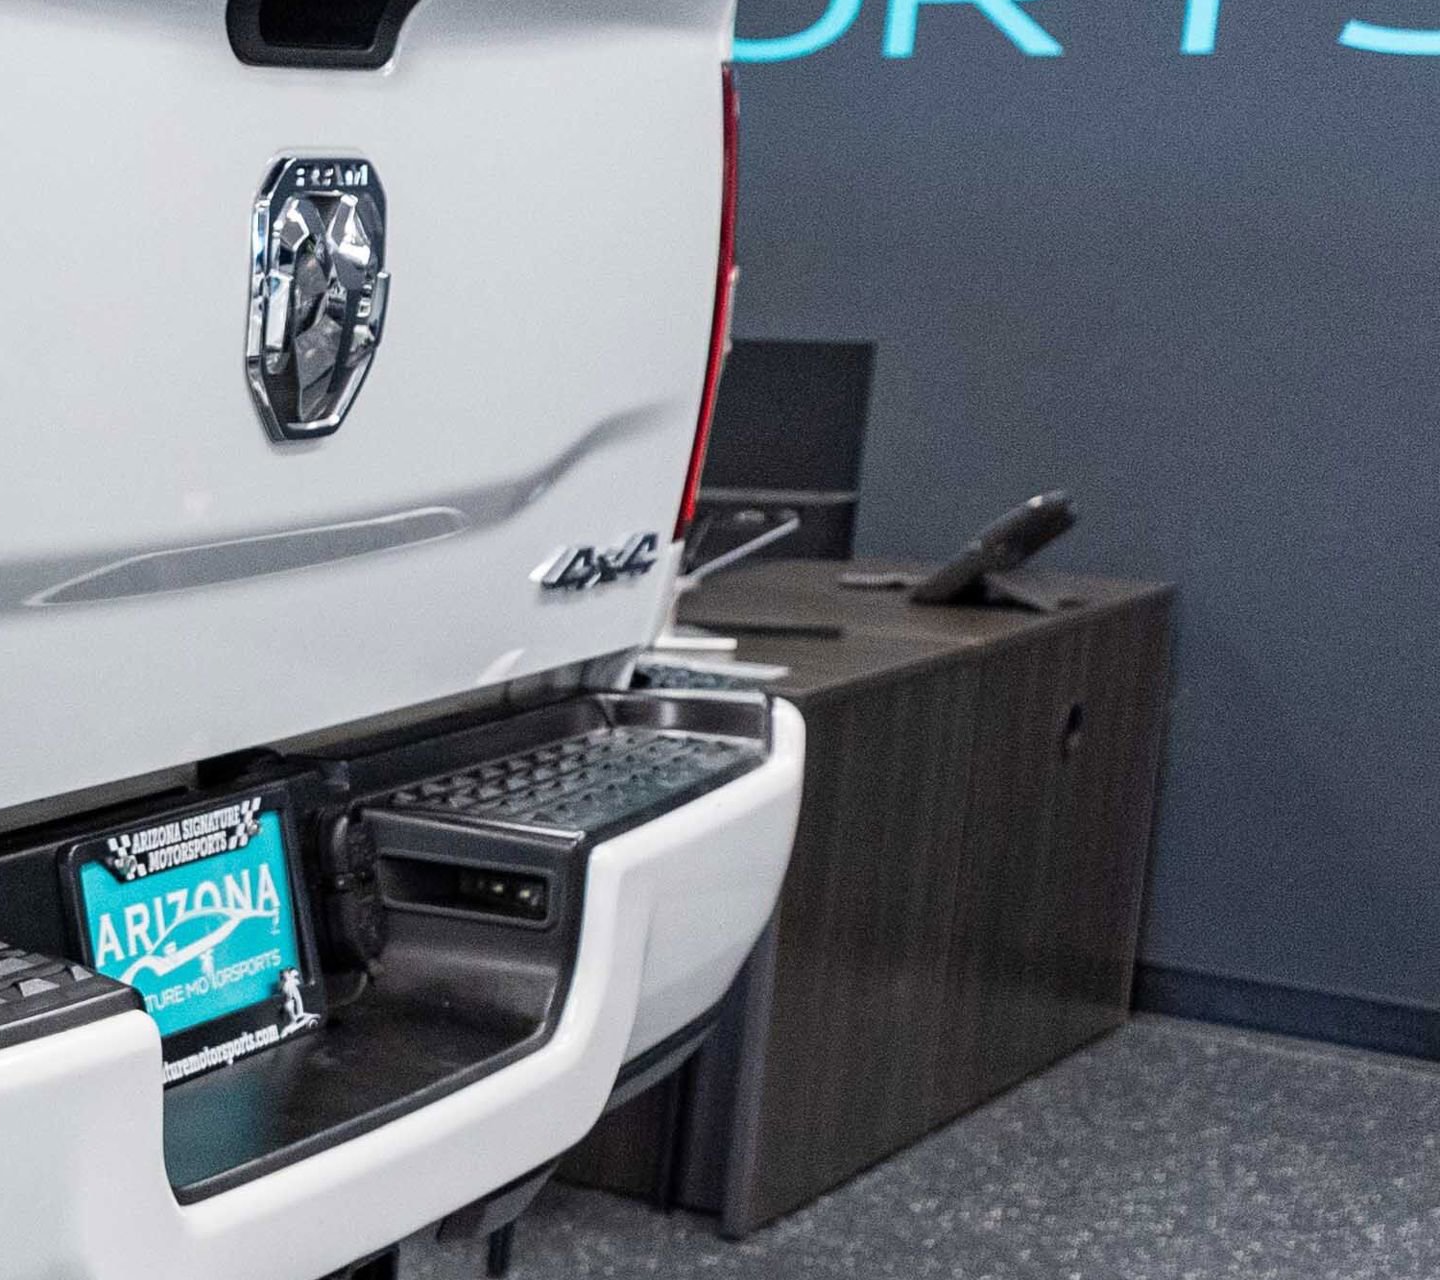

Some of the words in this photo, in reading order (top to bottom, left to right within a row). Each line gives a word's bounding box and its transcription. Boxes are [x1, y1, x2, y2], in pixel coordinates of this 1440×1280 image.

[295, 163, 369, 187] RAM
[131, 821, 182, 854] ARIZONA
[181, 804, 241, 840] SIGNATURE
[148, 830, 227, 872] MOTORSPORTS
[96, 863, 280, 968] ARIZONA
[145, 984, 185, 1013] TURE
